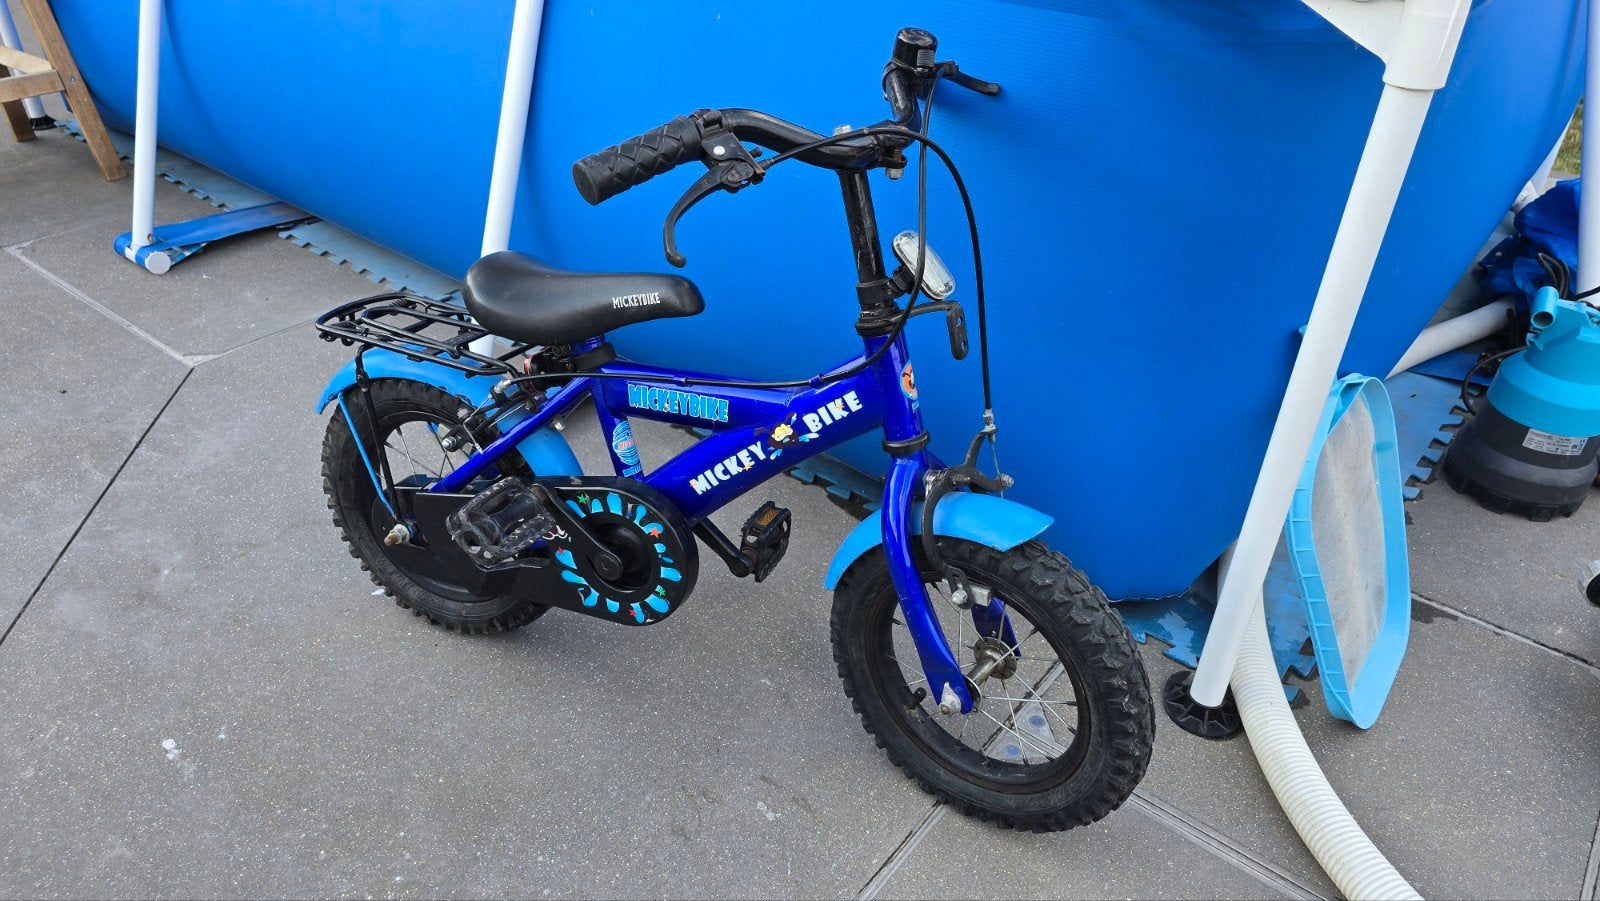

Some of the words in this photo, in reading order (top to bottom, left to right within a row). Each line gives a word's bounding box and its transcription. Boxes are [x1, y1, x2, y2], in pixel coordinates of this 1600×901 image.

[612, 292, 660, 309] MICKEYBIKE
[628, 384, 729, 422] MICKEYBIKE
[690, 441, 767, 495] MICKEY
[802, 390, 863, 433] BIKE
